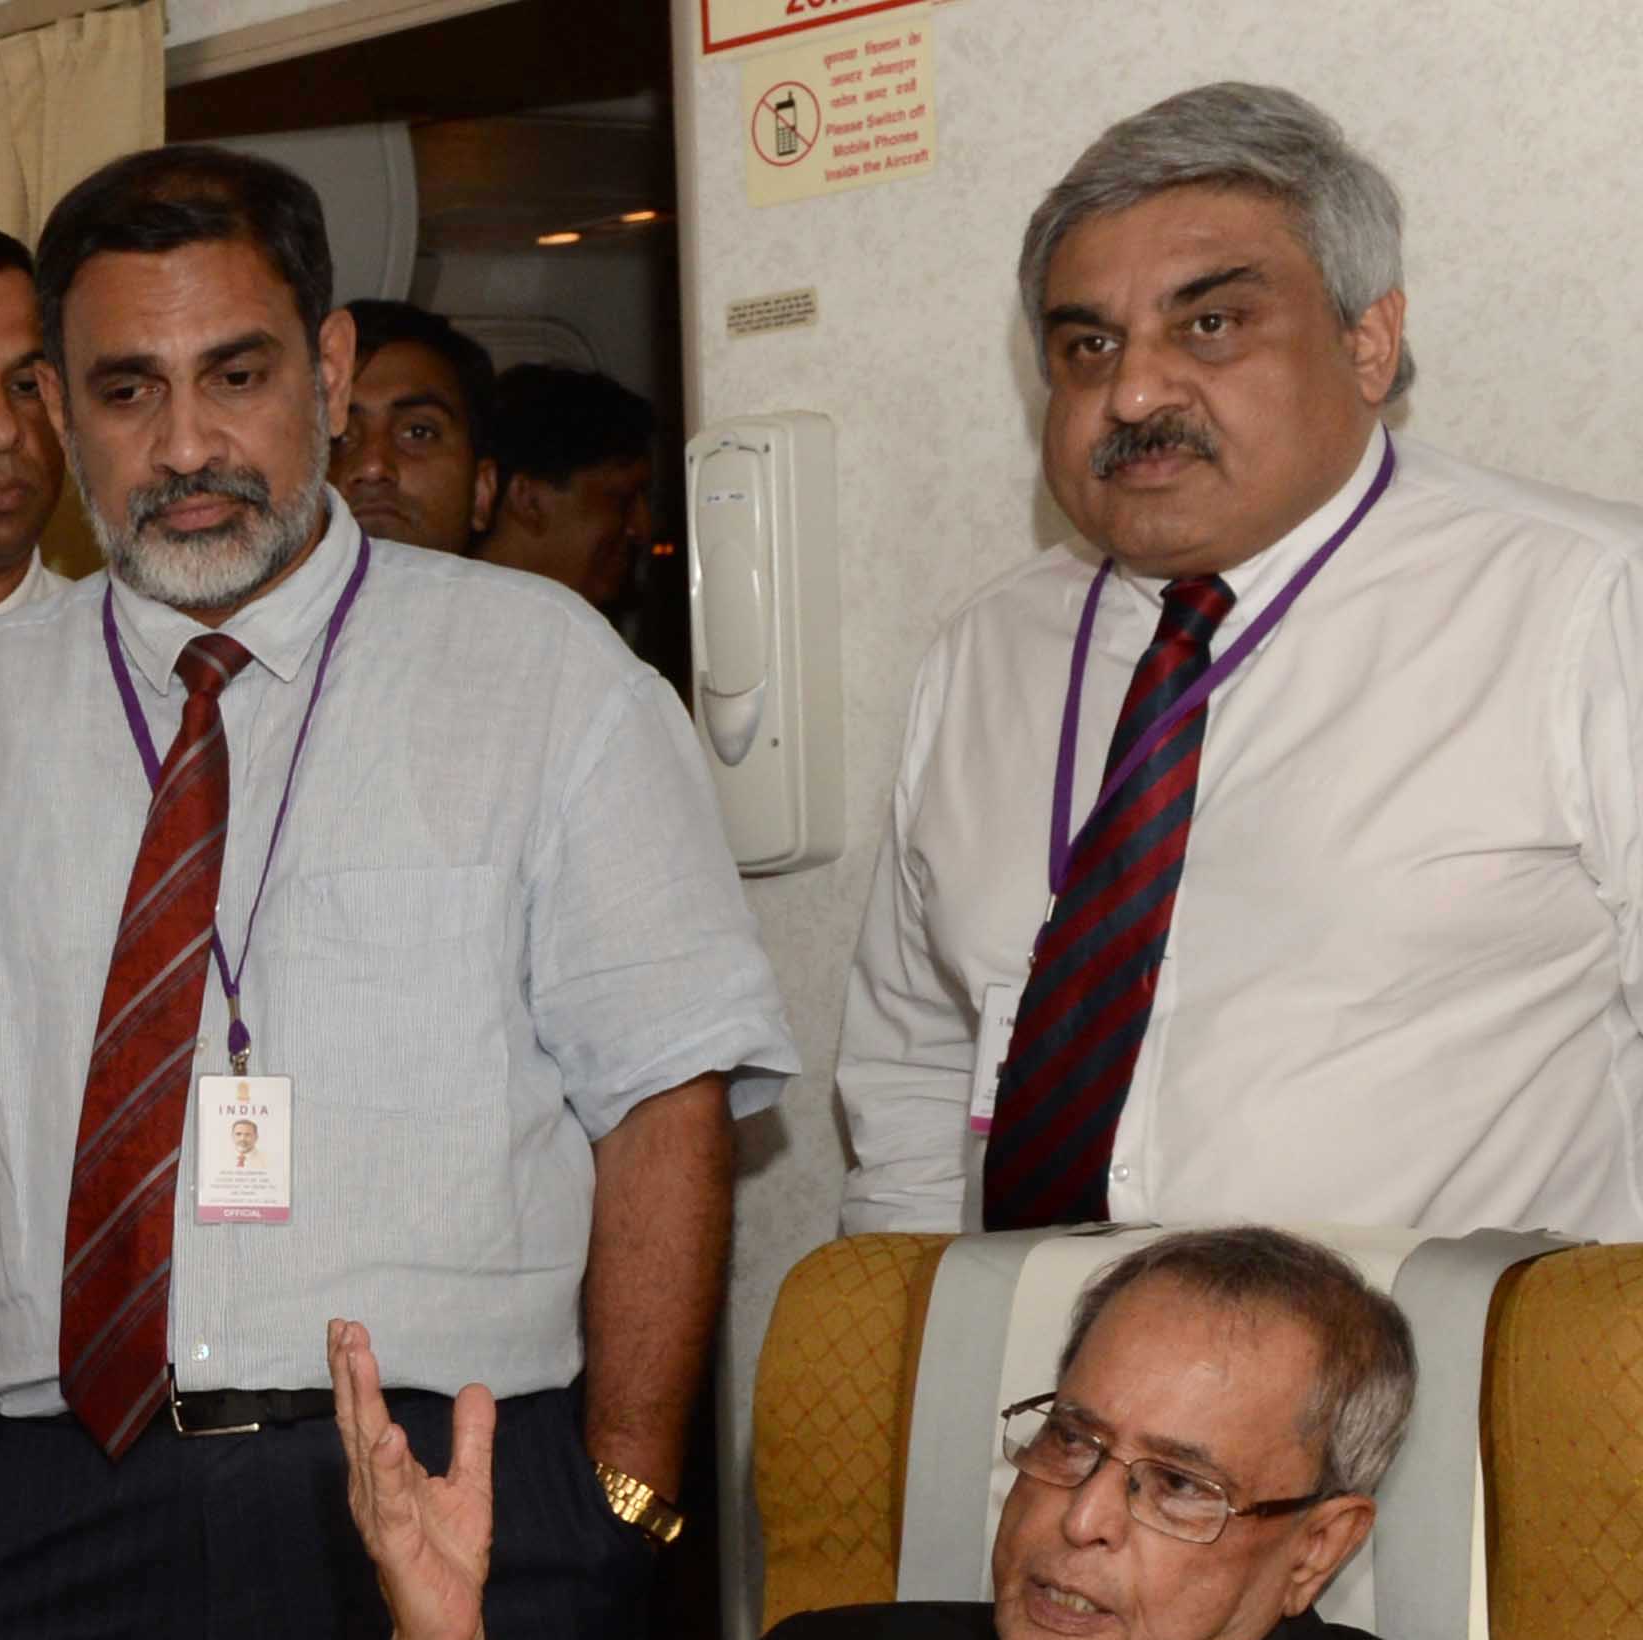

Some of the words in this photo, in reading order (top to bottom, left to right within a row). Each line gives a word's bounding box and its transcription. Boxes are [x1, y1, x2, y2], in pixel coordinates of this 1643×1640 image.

[826, 120, 863, 136] Please
[866, 110, 906, 128] Switch
[909, 104, 926, 119] off
[833, 141, 870, 157] Mobile
[874, 130, 918, 147] Phones
[825, 164, 860, 181] Inside
[862, 160, 881, 174] the
[885, 148, 929, 168] Aircraft
[218, 1104, 269, 1116] INDIA
[223, 1208, 262, 1218] OFFICIAL
